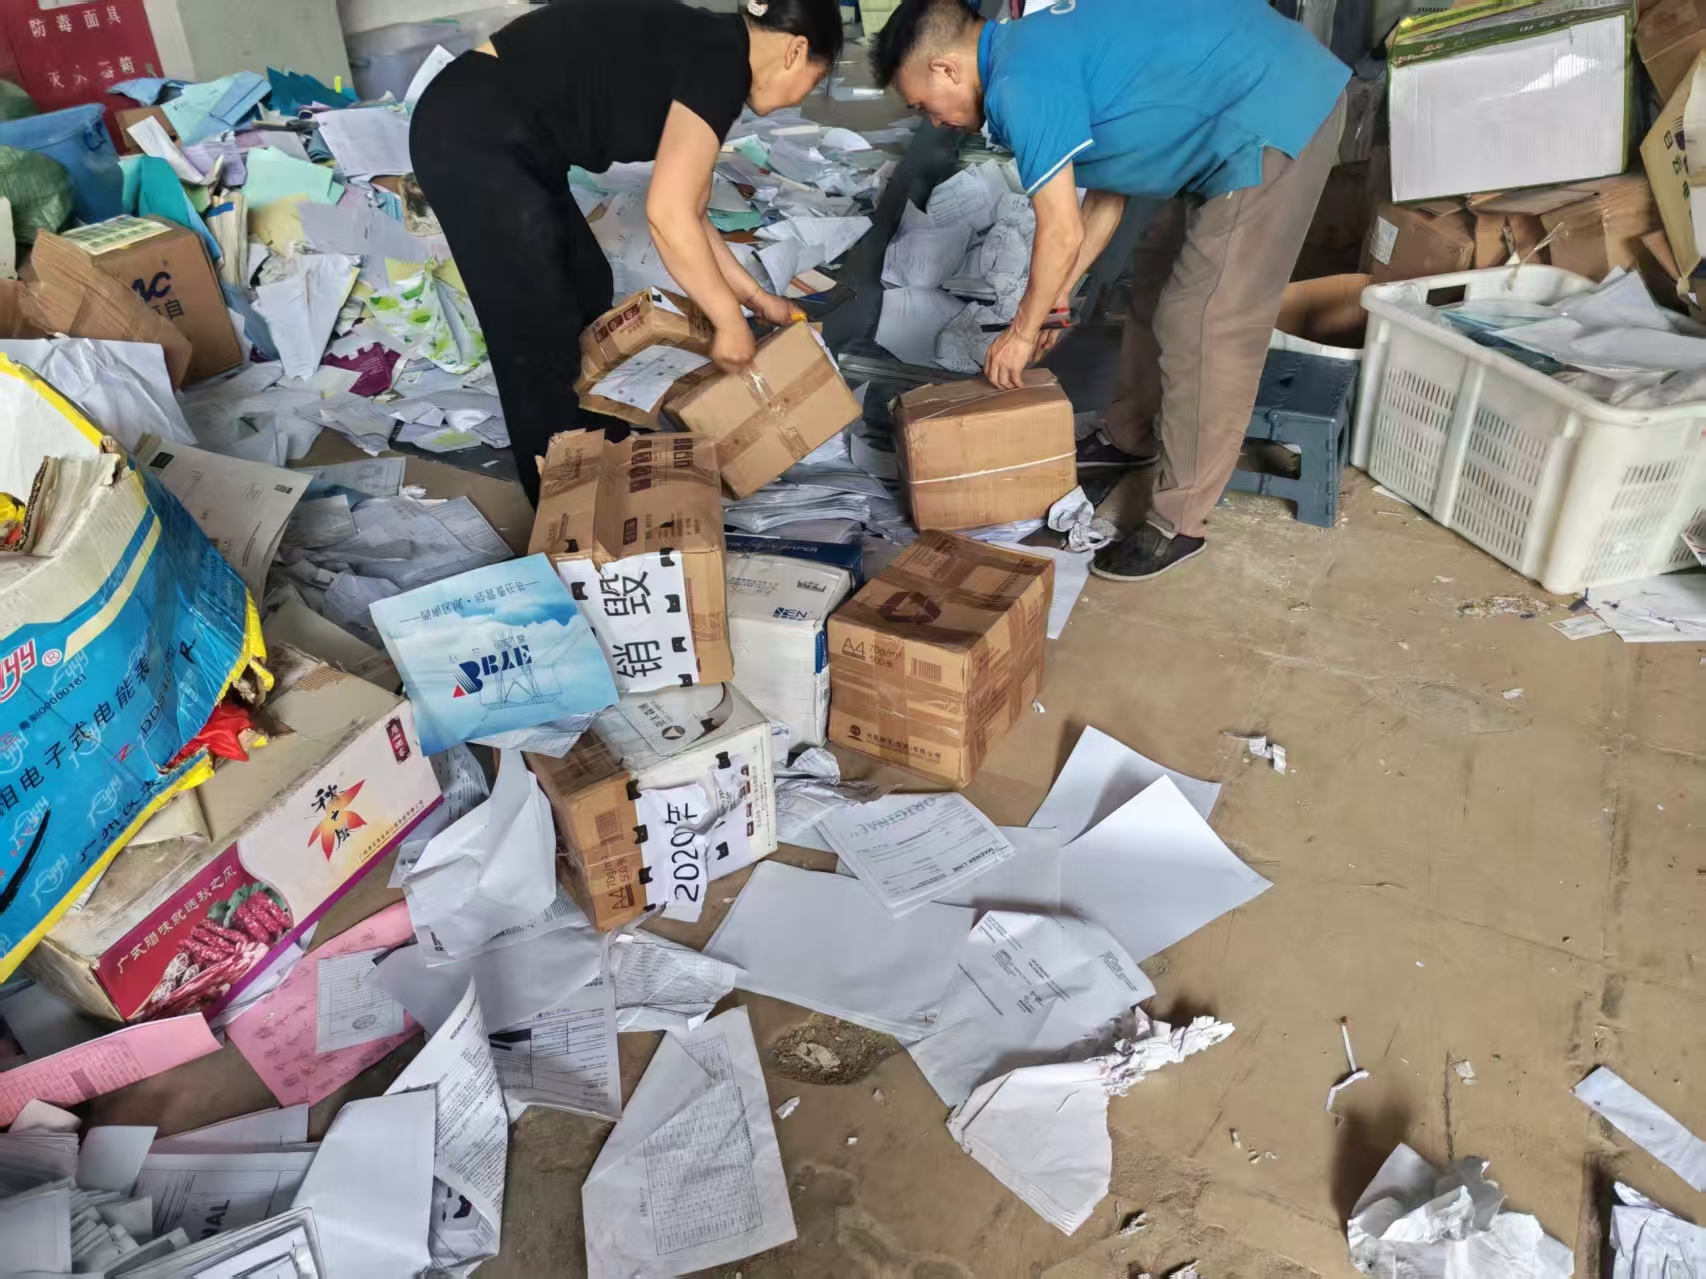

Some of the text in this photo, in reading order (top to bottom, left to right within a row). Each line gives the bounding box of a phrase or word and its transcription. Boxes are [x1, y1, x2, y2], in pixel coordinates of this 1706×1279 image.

[28, 5, 121, 38] 防毒面具
[600, 571, 662, 679] 销毁
[841, 637, 865, 656] A4
[665, 803, 699, 902] 2020年
[951, 860, 968, 873] LINE
[608, 887, 630, 910] A4
[117, 867, 238, 974] 广式腊味就选秋之风
